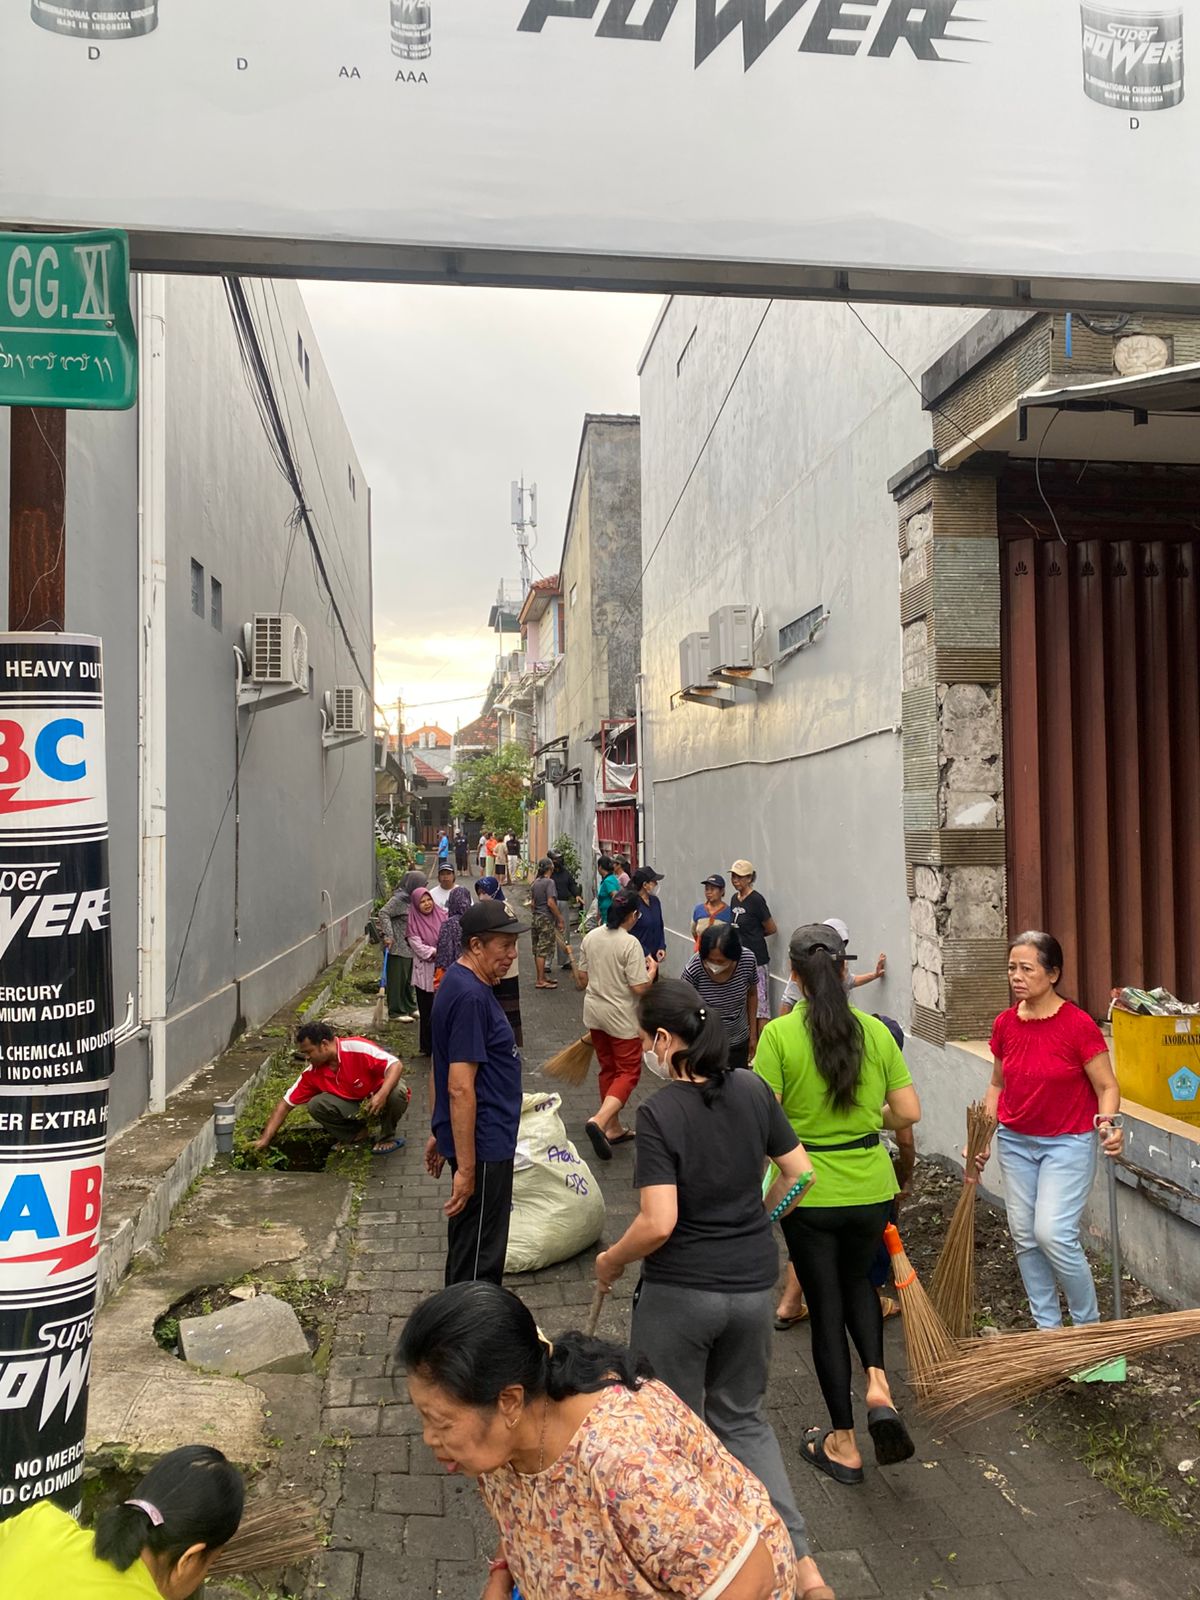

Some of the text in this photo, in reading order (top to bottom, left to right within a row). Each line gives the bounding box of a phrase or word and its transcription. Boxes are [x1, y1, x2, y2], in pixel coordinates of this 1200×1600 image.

[1106, 22, 1159, 42] Super
[88, 46, 101, 60] D
[236, 57, 248, 71] D
[338, 66, 362, 79] AA
[395, 69, 429, 84] AAA
[1129, 117, 1140, 130] D
[6, 660, 74, 679] HEAVY
[41, 999, 95, 1021] ADDED
[7, 1041, 73, 1061] CHEMICAL
[8, 1060, 84, 1080] INDONESIA
[30, 1108, 97, 1131] EXTRA
[14, 1458, 42, 1480] NO
